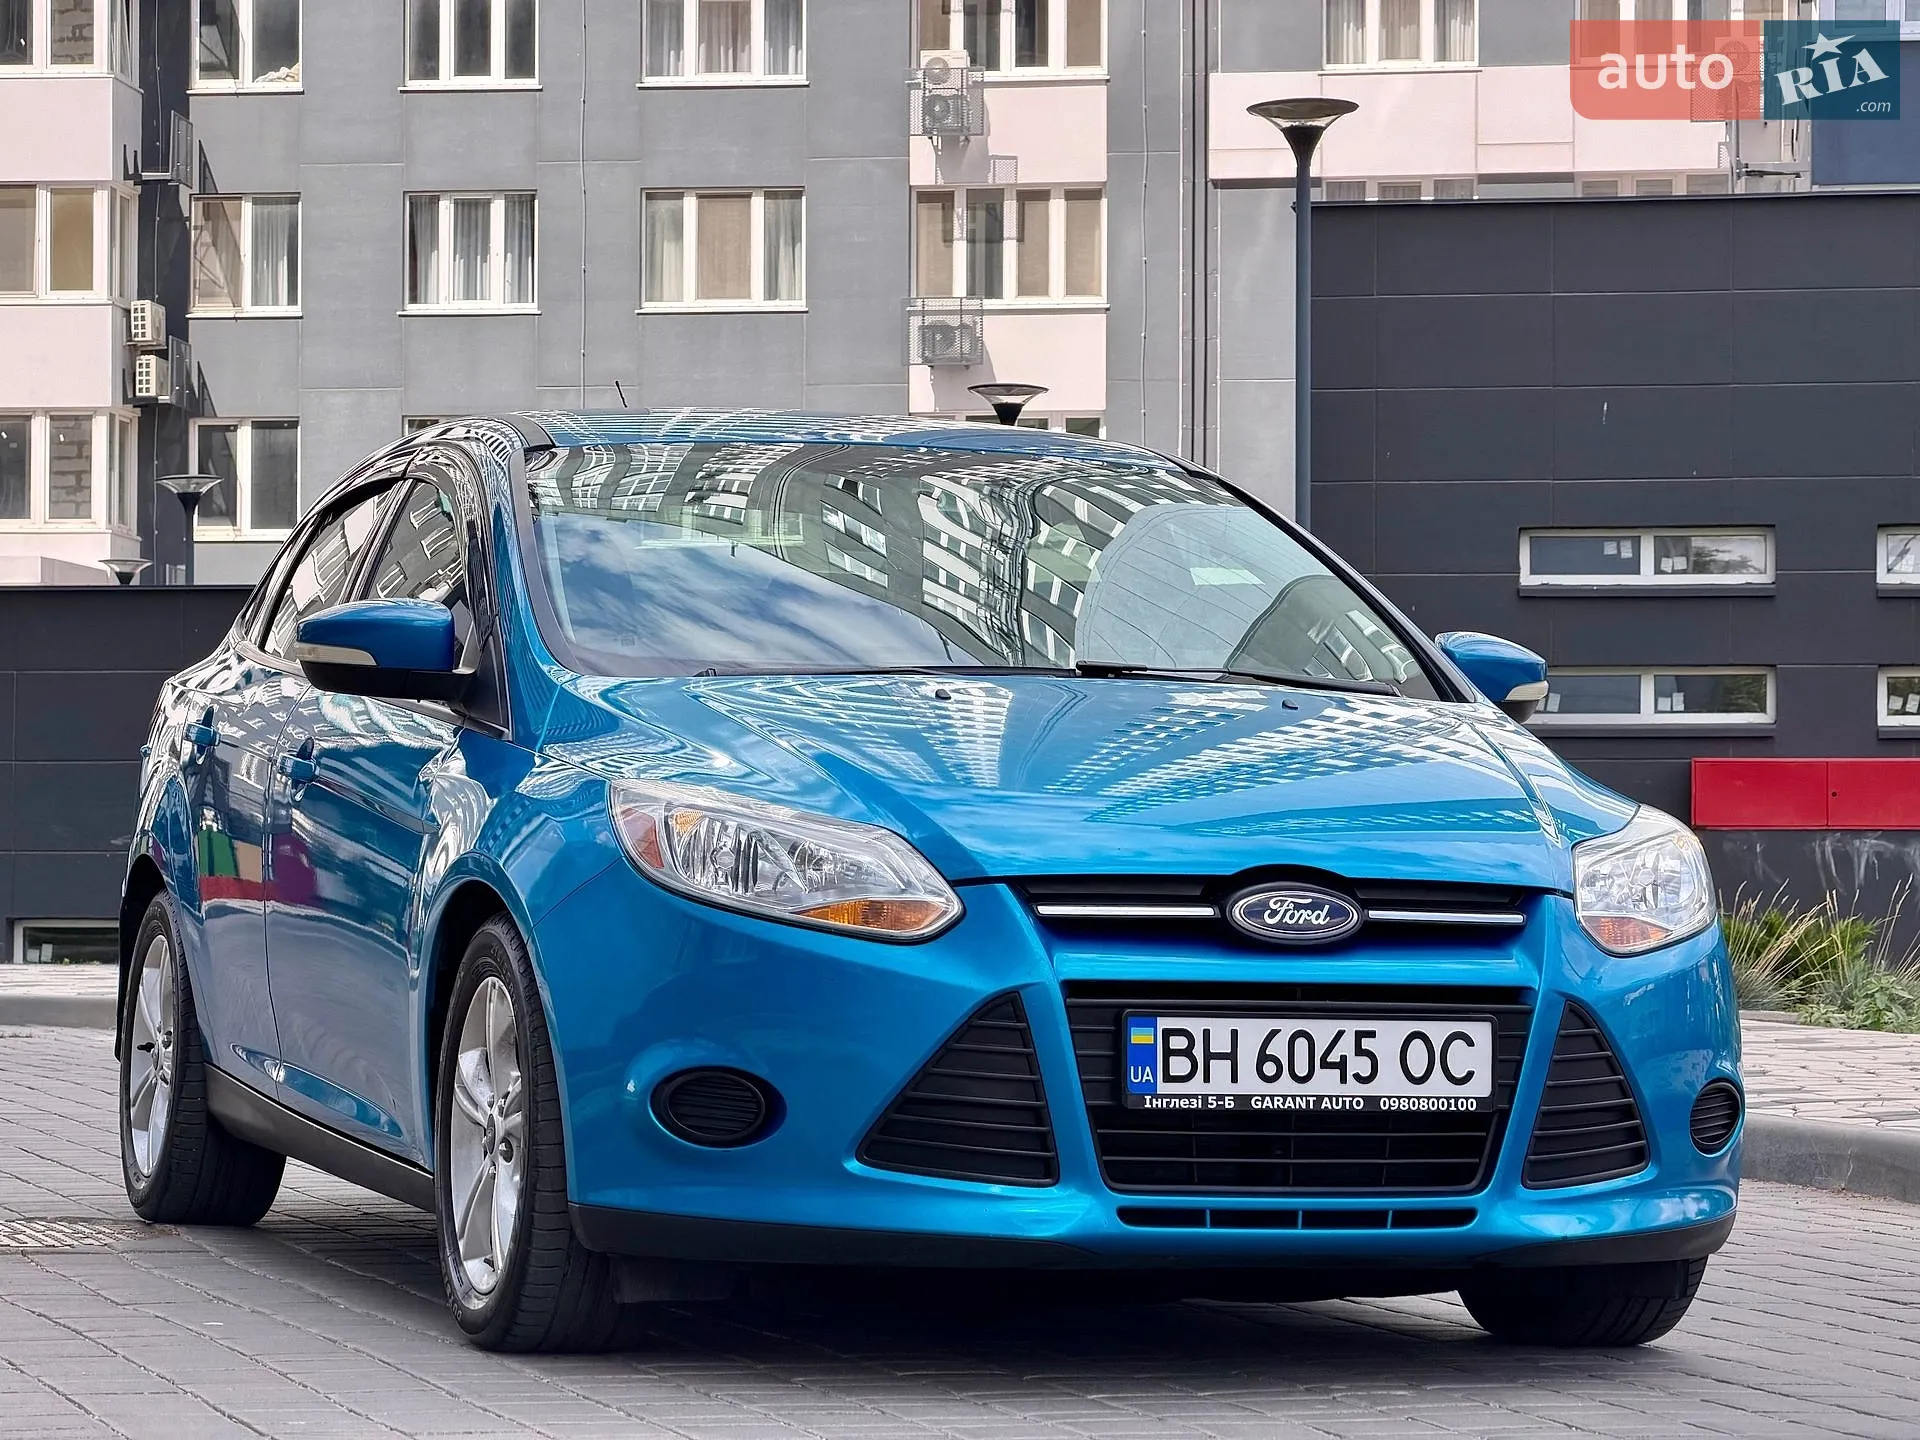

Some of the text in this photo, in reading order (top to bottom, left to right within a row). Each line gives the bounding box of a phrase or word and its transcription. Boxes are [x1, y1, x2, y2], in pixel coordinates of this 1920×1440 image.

[1263, 896, 1331, 925] Ford
[1161, 1027, 1475, 1086] BH 6045 OC
[1130, 1065, 1154, 1084] UA
[1144, 1095, 1477, 1111] Інглезі 5-Б GARANT AUTO 0980800100
